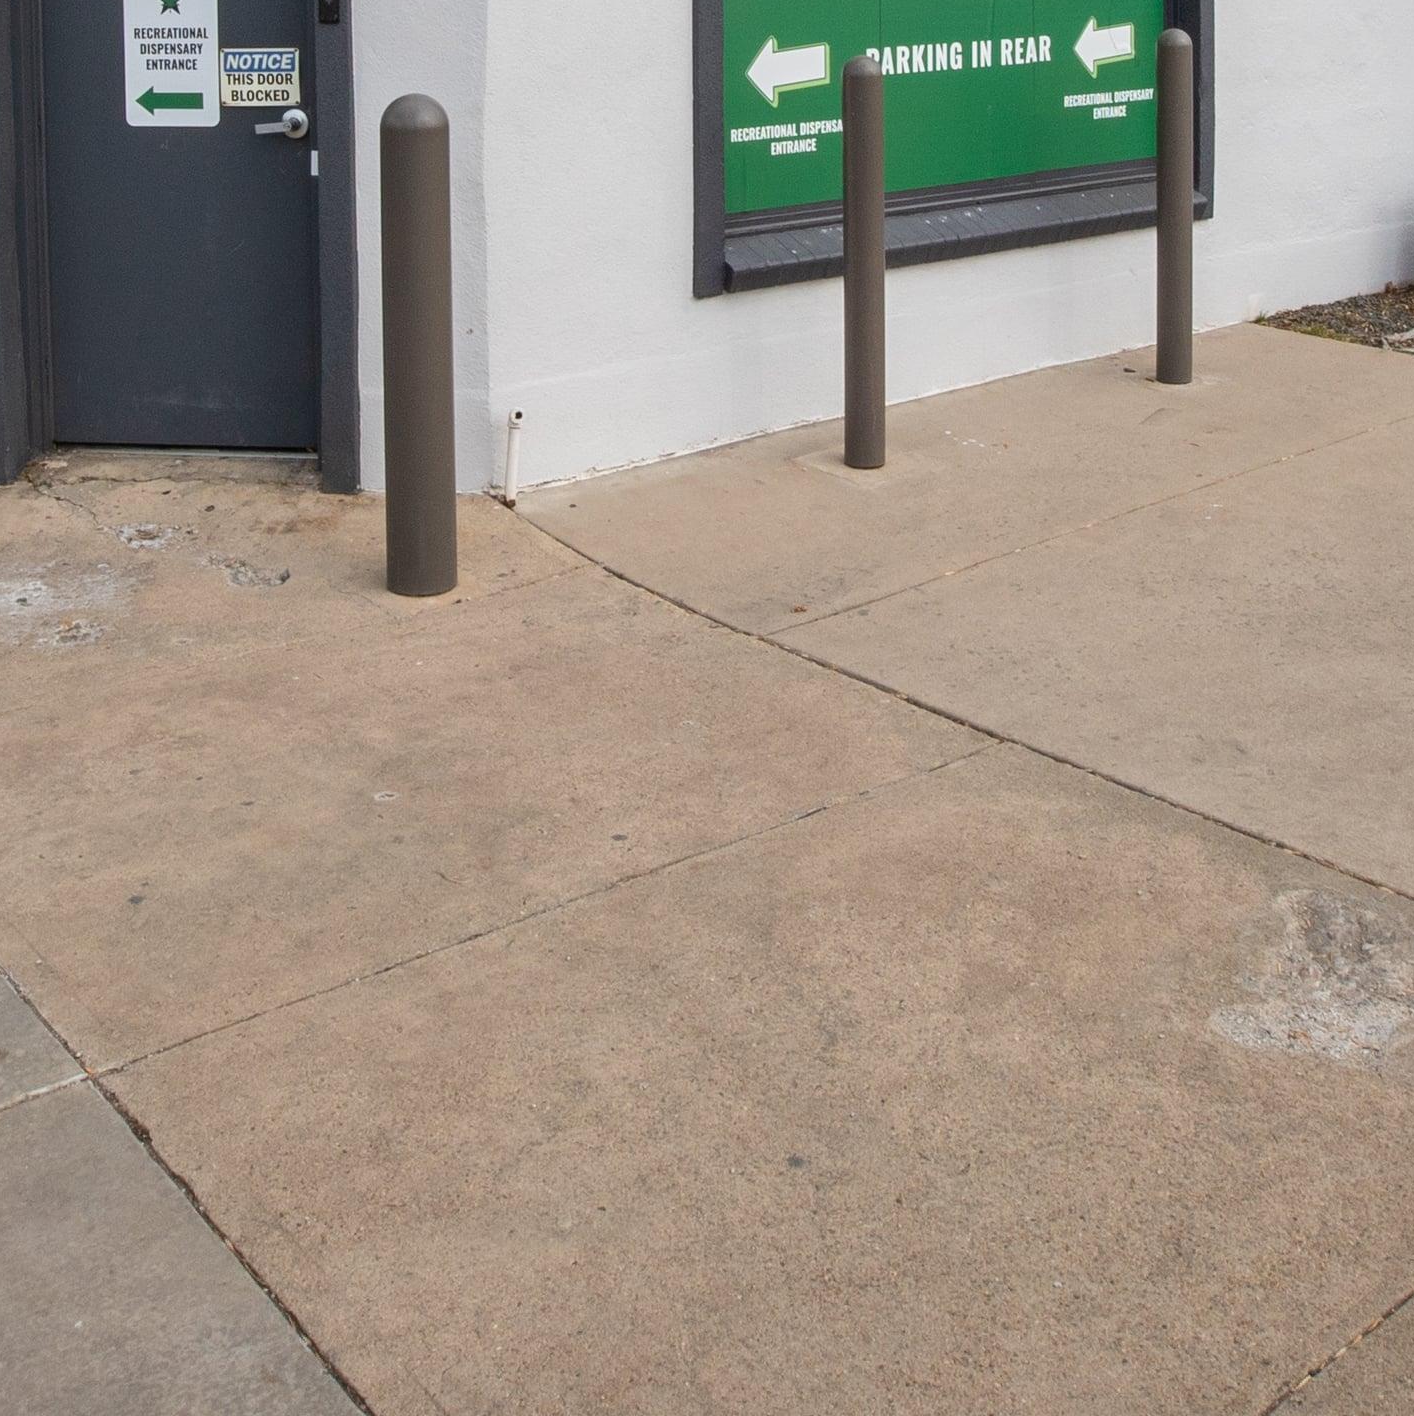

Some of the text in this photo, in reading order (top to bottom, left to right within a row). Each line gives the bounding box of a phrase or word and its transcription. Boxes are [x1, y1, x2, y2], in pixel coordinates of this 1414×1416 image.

[134, 27, 209, 40] RECREATIONAL
[140, 43, 203, 56] DISPENSARY
[971, 39, 992, 68] IN
[1000, 35, 1052, 66] REAR
[146, 58, 198, 71] ENTRANCE
[225, 53, 294, 70] NOTICE
[226, 72, 294, 86] THIS DOOR
[231, 89, 290, 102] BLOCKED
[1064, 88, 1154, 107] RECREATIONAL DISPENSARY
[1093, 105, 1127, 119] ENTRANCE
[730, 119, 844, 143] RECREATIONAL DISPENSA
[771, 138, 818, 155] ENTRANCE
